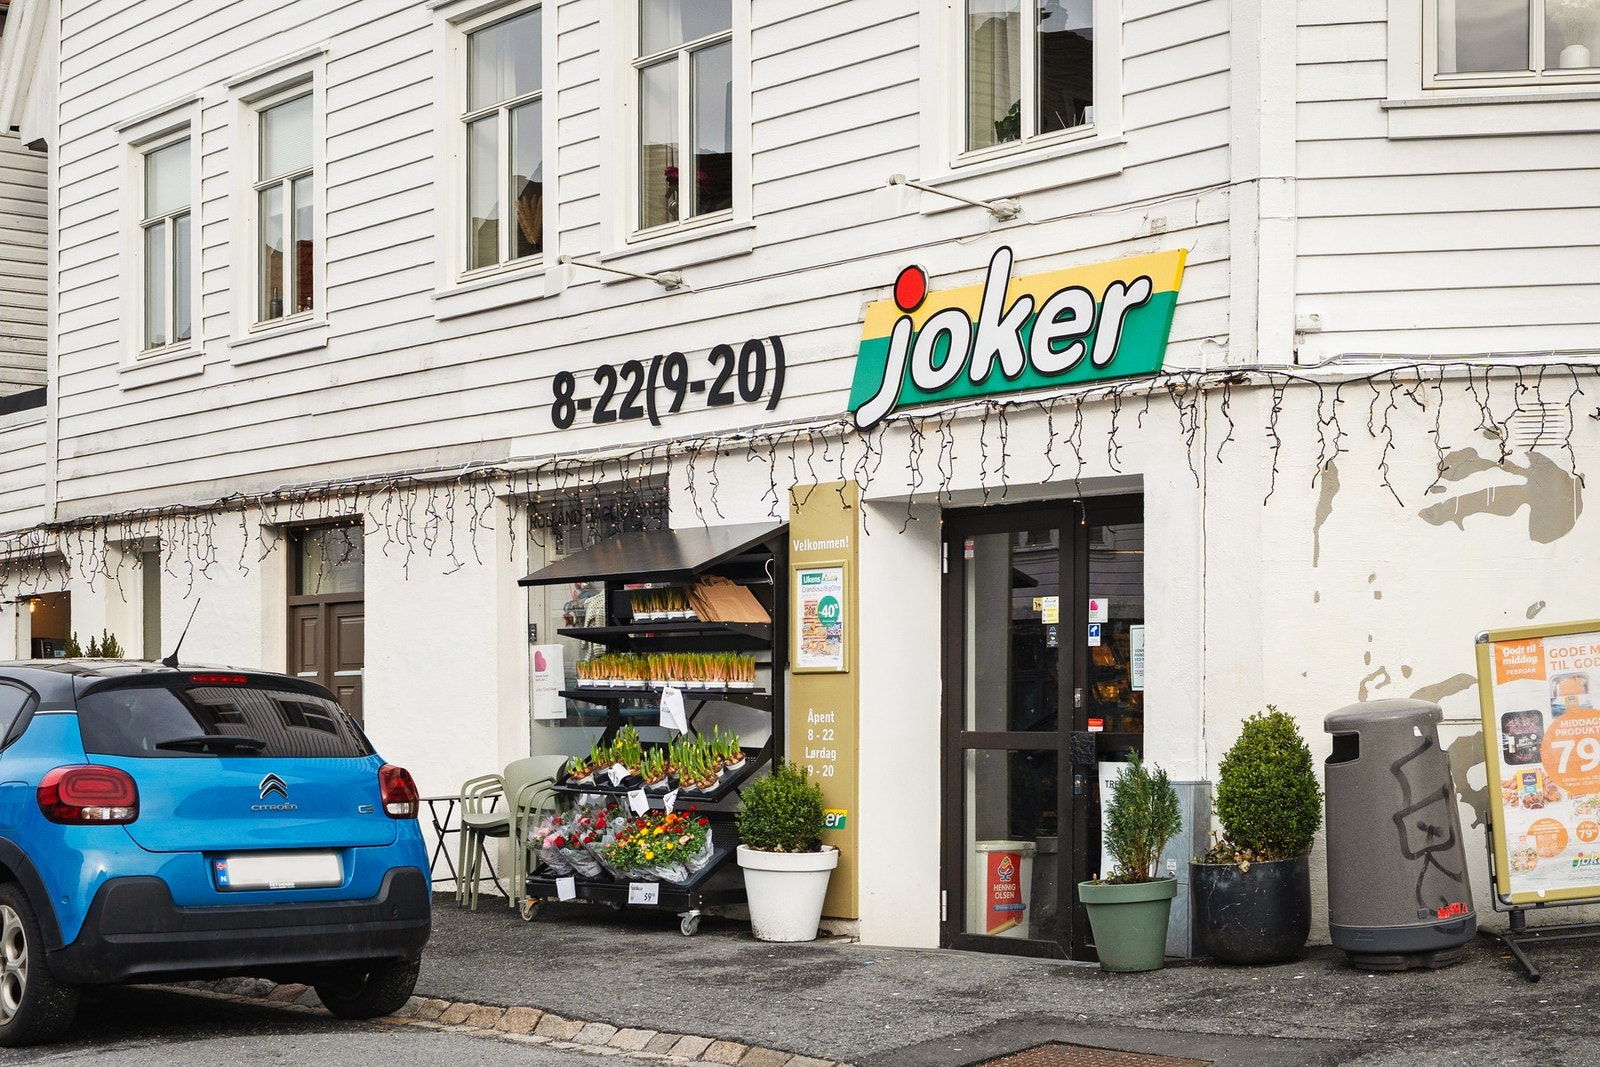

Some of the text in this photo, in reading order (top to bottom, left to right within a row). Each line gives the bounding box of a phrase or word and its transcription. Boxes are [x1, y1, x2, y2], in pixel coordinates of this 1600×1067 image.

[854, 245, 1153, 431] joker
[793, 535, 849, 552] Velkommen!
[1502, 644, 1536, 657] Godt til
[1549, 646, 1586, 659] GODE
[1502, 655, 1538, 665] middag
[1550, 660, 1570, 671] TIL
[1505, 667, 1537, 676] FEBRUAR
[807, 708, 835, 725] Åpent
[807, 728, 814, 741] 8
[822, 728, 835, 741] 22
[805, 746, 837, 761] Lørdag
[1550, 737, 1600, 774] 79
[807, 764, 814, 777] 9
[822, 764, 834, 777] 20
[1575, 851, 1600, 869] jok
[644, 892, 652, 901] 59
[994, 891, 1015, 899] OLSEN
